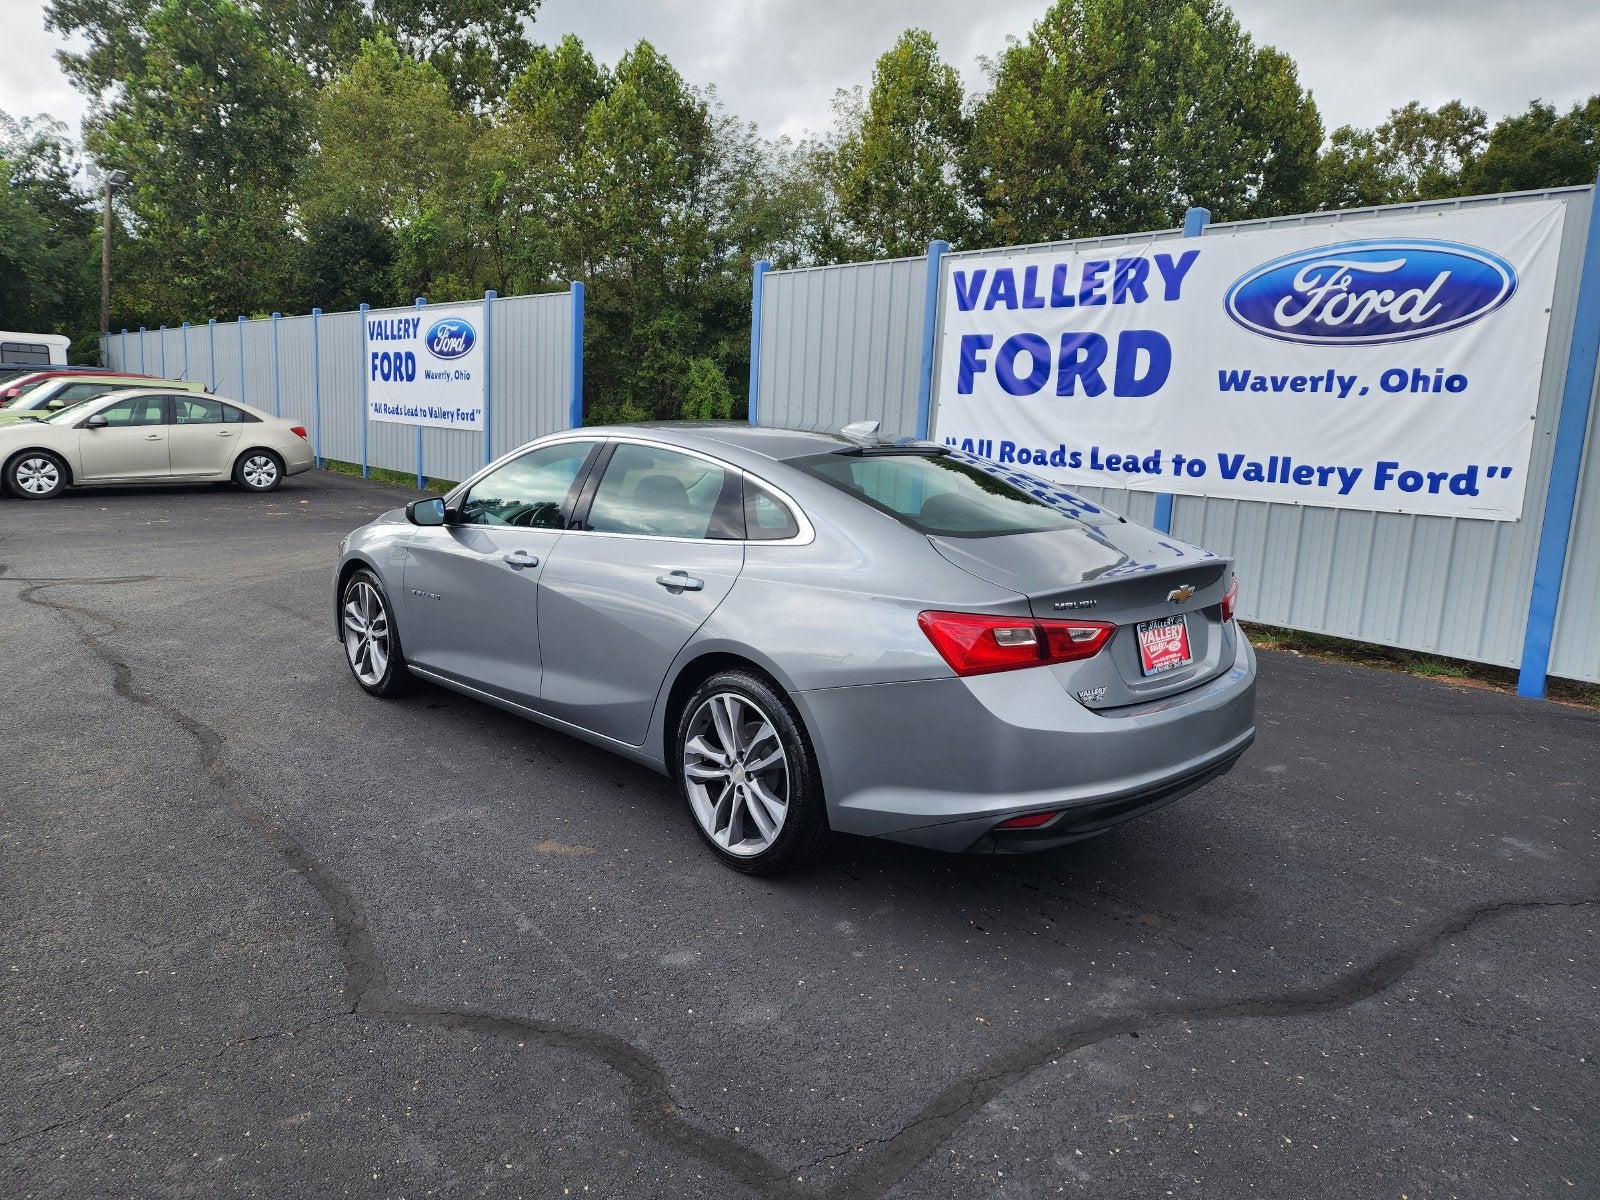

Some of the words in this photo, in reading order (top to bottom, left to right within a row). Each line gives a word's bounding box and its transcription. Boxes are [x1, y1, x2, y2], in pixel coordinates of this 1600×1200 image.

[953, 250, 1201, 311] VALLERY
[1274, 257, 1451, 327] Ford
[368, 317, 420, 341] VALLERY
[433, 324, 467, 352] Ford
[371, 351, 416, 382] FORD
[424, 369, 453, 382] Waverly,
[454, 369, 471, 380] Ohio
[957, 330, 1172, 398] FORD
[1218, 368, 1369, 398] Waverly,
[1379, 367, 1468, 392] Ohio
[383, 403, 403, 415] Roads
[403, 404, 419, 417] Lead
[420, 408, 427, 418] to
[428, 406, 455, 422] Vallery
[999, 440, 1083, 469] Roads
[1090, 446, 1162, 475] Lead
[1172, 454, 1207, 478] to
[1217, 453, 1364, 495] Vallery
[1373, 461, 1513, 497] Ford"
[1140, 623, 1183, 645] VALLERY
[1149, 617, 1175, 630] VALLERY
[1078, 686, 1107, 698] VALLERY
